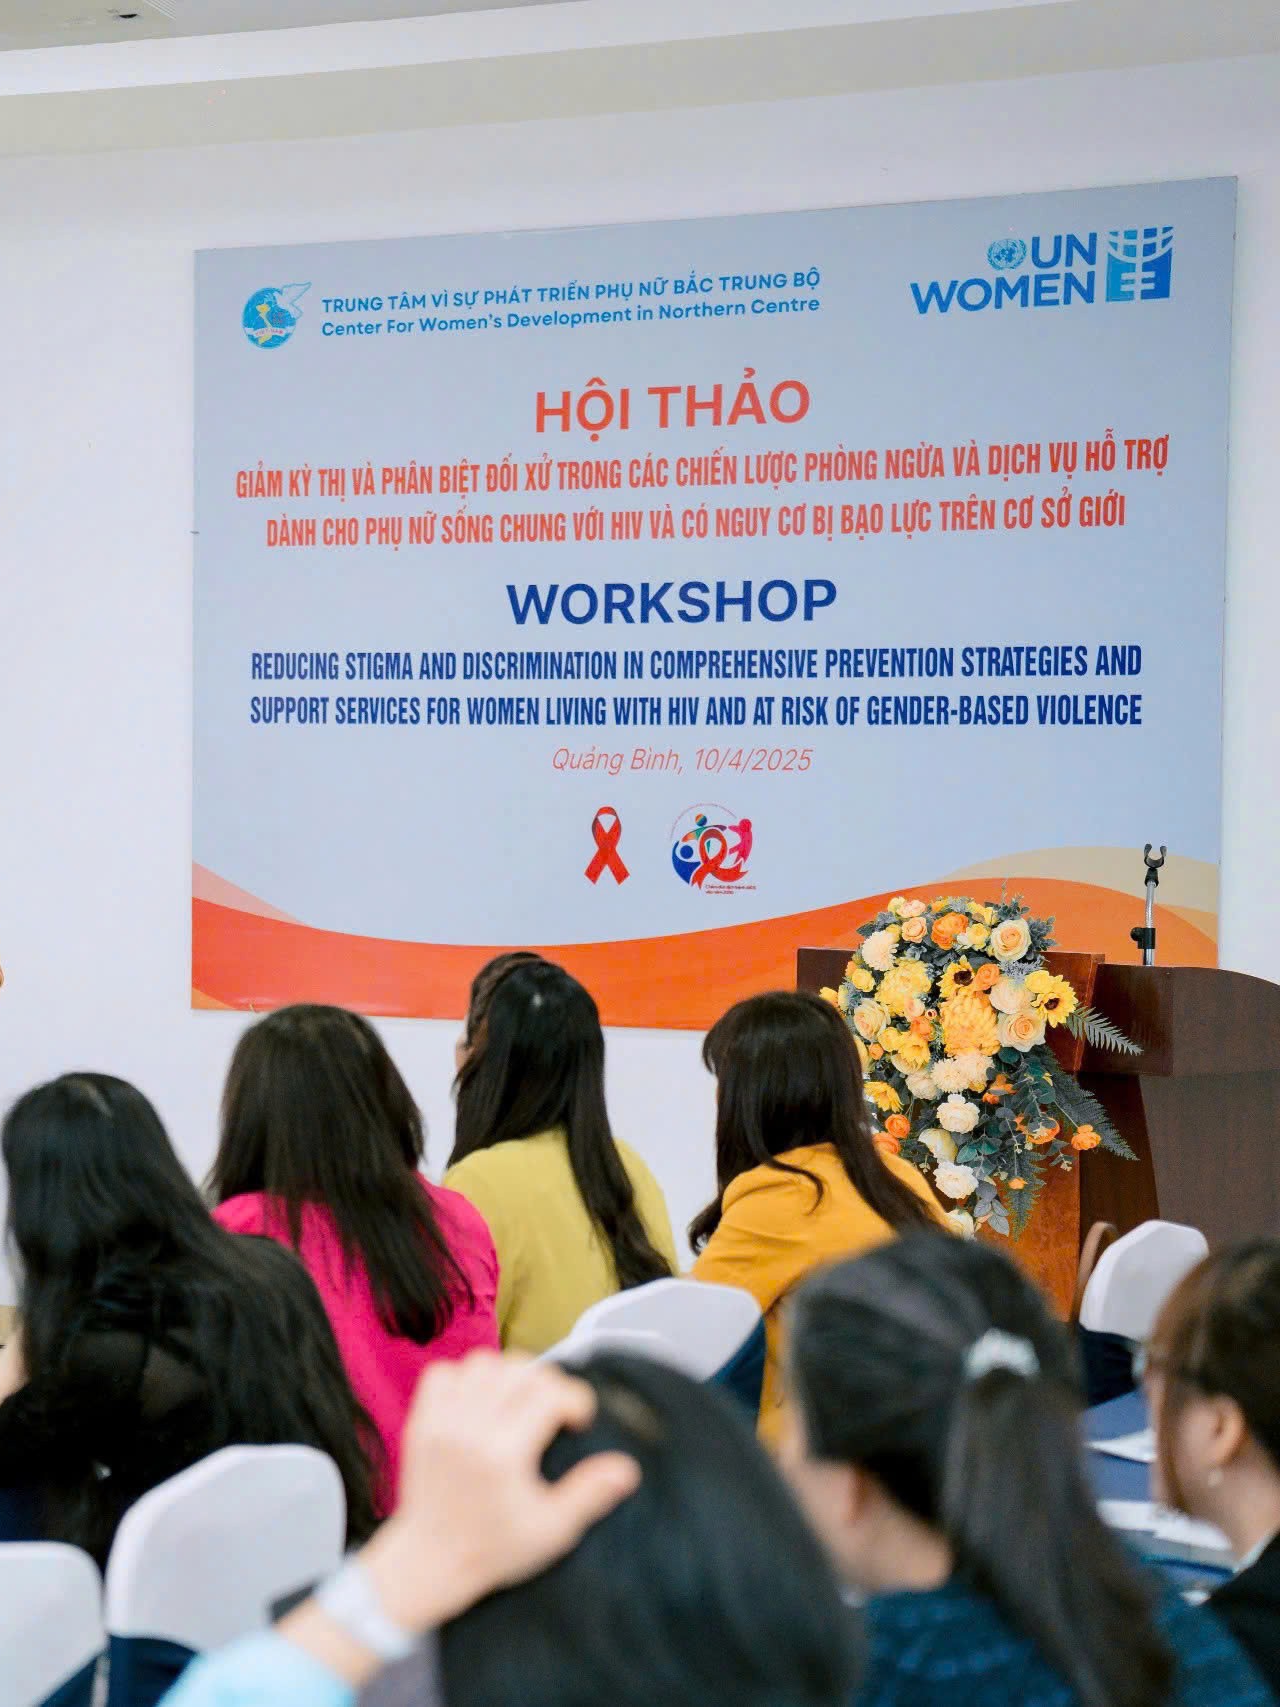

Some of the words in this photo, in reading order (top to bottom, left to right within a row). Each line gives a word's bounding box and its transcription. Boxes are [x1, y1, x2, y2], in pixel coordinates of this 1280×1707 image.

[1032, 232, 1097, 269] UN
[322, 297, 383, 312] TRUNG
[388, 292, 425, 309] TÂM
[432, 290, 448, 307] VÌ
[454, 290, 479, 309] SỰ
[484, 285, 532, 304] PHÁT
[595, 283, 632, 301] PHỤ
[639, 277, 669, 296] NỮ
[719, 274, 787, 291] TRUNG
[793, 267, 820, 290] BỘ
[910, 272, 1095, 314] WOMEN
[322, 322, 382, 336] Center
[388, 320, 414, 333] For
[508, 308, 631, 328] Development
[637, 305, 653, 320] in
[659, 302, 745, 319] Northern
[751, 299, 820, 314] Centre
[536, 376, 629, 442] HỘI
[648, 368, 809, 428] THẢO
[236, 460, 282, 498] GIẢM
[289, 463, 311, 496] KỲ
[318, 469, 345, 501] THỊ
[352, 461, 375, 495] VÀ
[382, 461, 432, 494] PHÂN
[440, 459, 480, 499] BIỆT
[486, 458, 517, 492] ĐỐI
[557, 460, 621, 489] TRONG
[629, 453, 668, 488] CÁC
[676, 446, 736, 486] CHIẾN
[745, 451, 796, 489] LƯỢC
[805, 445, 877, 481] PHÒNG
[885, 442, 944, 479] NGỪA
[953, 440, 980, 476] VÀ
[988, 444, 1040, 481] DỊCH
[1049, 442, 1077, 479] VỤ
[1086, 428, 1115, 471] HỖ
[1124, 434, 1169, 476] TRỢ
[267, 514, 316, 546] DÀNH
[323, 518, 359, 545] CHO
[366, 517, 402, 551] PHỤ
[409, 511, 436, 544] NỮ
[441, 505, 493, 544] SỐNG
[500, 513, 566, 542] CHUNG
[573, 505, 603, 541] VỚI
[612, 511, 643, 540] HIV
[650, 504, 674, 538] VÀ
[682, 504, 708, 538] CÓ
[716, 508, 770, 536] NGUY
[778, 504, 806, 536] CƠ
[813, 506, 833, 541] BỊ
[841, 504, 883, 540] BẠO
[891, 500, 931, 539] LỰC
[939, 494, 995, 531] TRÊN
[1004, 495, 1034, 529] CƠ
[1041, 486, 1072, 528] SỞ
[1079, 489, 1125, 527] GIỚI
[506, 579, 836, 624] WORKSHOP
[252, 653, 338, 680] REDUCING
[346, 652, 413, 680] STIGMA
[419, 652, 456, 680] AND
[463, 651, 616, 680] DISCRIMINATION
[624, 651, 643, 679] IN
[651, 649, 817, 679] COMPREHENSIVE
[826, 648, 953, 678] PREVENTION
[961, 646, 1087, 676] STRATEGIES
[1095, 645, 1141, 675] AND
[251, 697, 329, 724] SUPPORT
[336, 697, 420, 725] SERVICES
[427, 697, 460, 725] FOR
[467, 697, 539, 725] WOMEN
[546, 697, 606, 725] LIVING
[613, 697, 661, 725] WITH
[669, 697, 699, 725] HIV
[706, 697, 746, 725] AND
[753, 697, 775, 725] AT
[782, 696, 828, 725] RISK
[836, 696, 860, 725] OF
[867, 695, 1028, 725] GENDER-BASED
[1037, 695, 1142, 725] VIOLENCE
[553, 746, 624, 775] Quảng
[631, 747, 682, 774] Bình,
[696, 749, 813, 773] 10/4/2025
